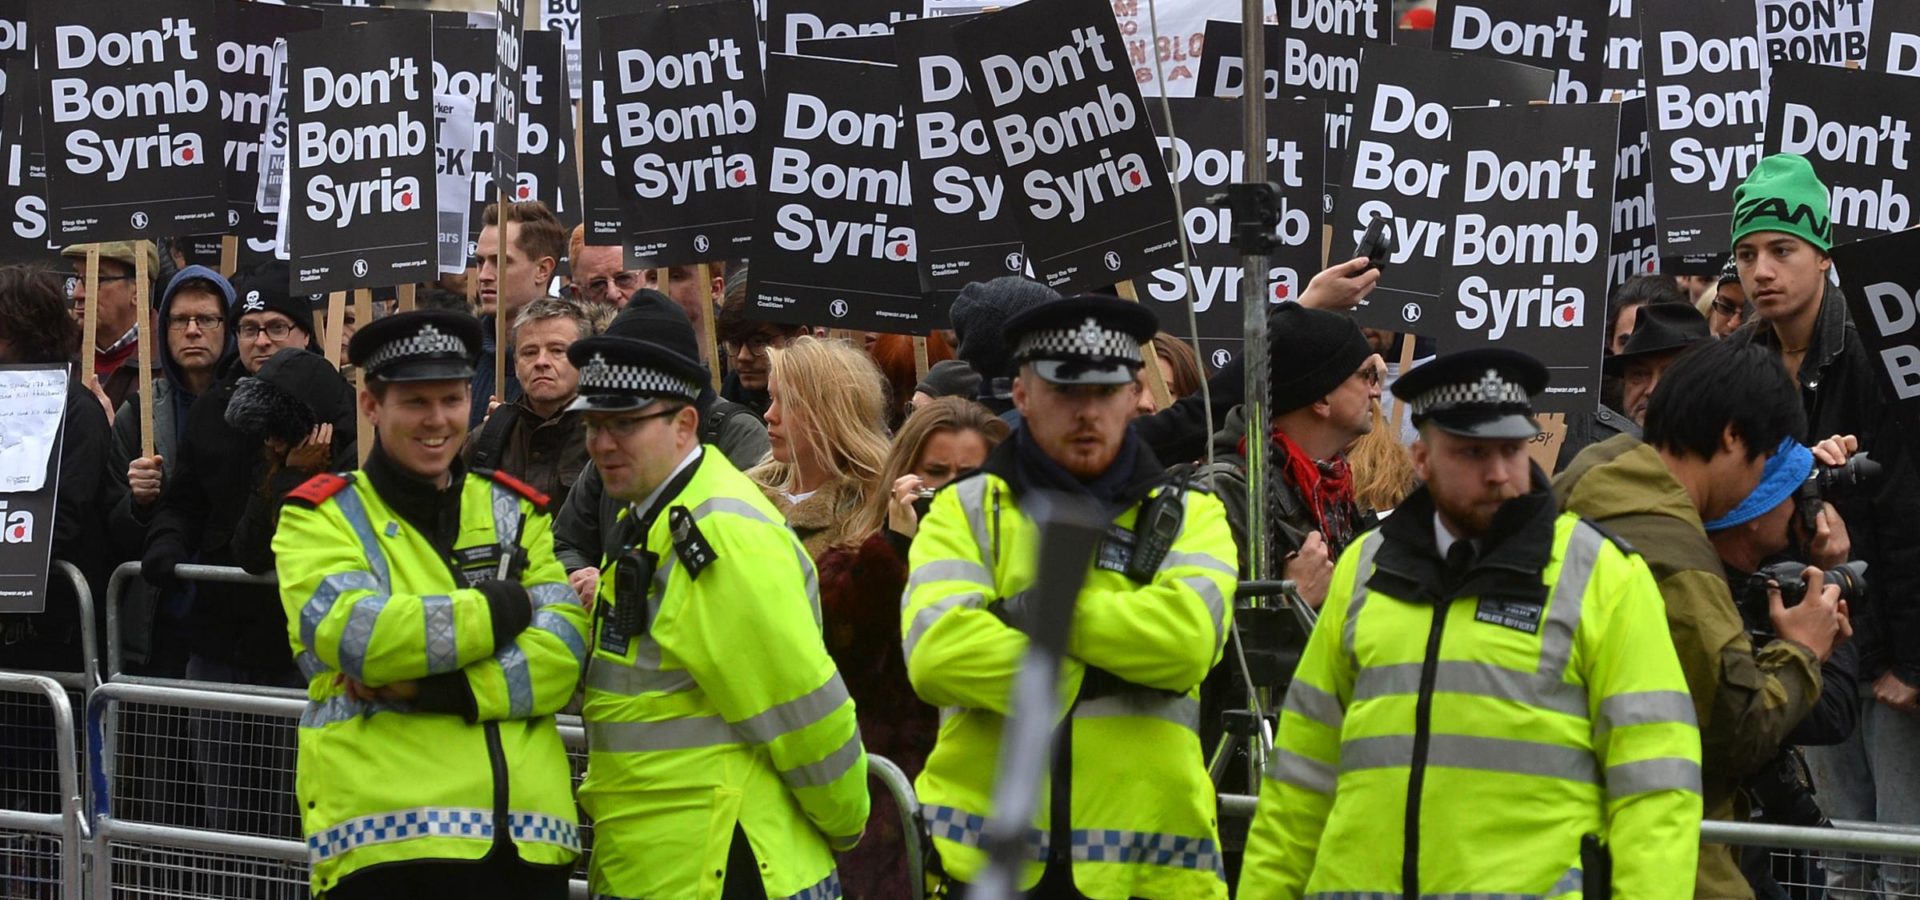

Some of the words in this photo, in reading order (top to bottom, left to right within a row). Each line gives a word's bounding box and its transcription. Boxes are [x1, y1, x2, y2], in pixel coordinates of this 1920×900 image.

[548, 0, 580, 14] BO
[1290, 0, 1378, 39] Don't
[1450, 5, 1588, 62] Don't
[1765, 0, 1863, 34] DON'T
[55, 17, 198, 69] Don't
[617, 38, 744, 94] Don't
[980, 26, 1113, 107] Don't
[1285, 38, 1363, 94] Bom
[1659, 30, 1758, 76] Don
[1766, 31, 1866, 64] BOMB
[51, 70, 209, 123] Bomb
[303, 57, 419, 113] Don't
[1656, 85, 1764, 131] Bom
[298, 111, 426, 168] Bomb
[616, 90, 756, 148] Bomb
[916, 111, 991, 160] Bo
[993, 84, 1136, 167] Bomb
[1780, 103, 1911, 170] Don't
[65, 124, 204, 182] Syria
[633, 145, 757, 205] Syria
[769, 147, 912, 206] Bom
[1464, 147, 1596, 203] Don't
[1670, 133, 1764, 191] Syri
[306, 168, 421, 228] Syria
[1023, 147, 1152, 223] Syria
[174, 213, 215, 221] stopwar.org.uk
[439, 232, 459, 243] ars
[773, 203, 918, 264] Syria
[1452, 210, 1599, 267] Bomb
[1143, 239, 1178, 253] stopwar.org.uk
[758, 294, 772, 302] Stop
[932, 269, 959, 277] Coalition
[1046, 272, 1058, 281] Stop
[1058, 269, 1068, 278] the
[1067, 266, 1078, 275] War
[1048, 275, 1071, 287] Coalition
[1148, 261, 1298, 313] Syra
[757, 301, 784, 309] Coalition
[876, 310, 918, 319] stopwar.org.uk
[1455, 274, 1585, 341] Syria
[1545, 386, 1586, 394] stopwar.org.uk
